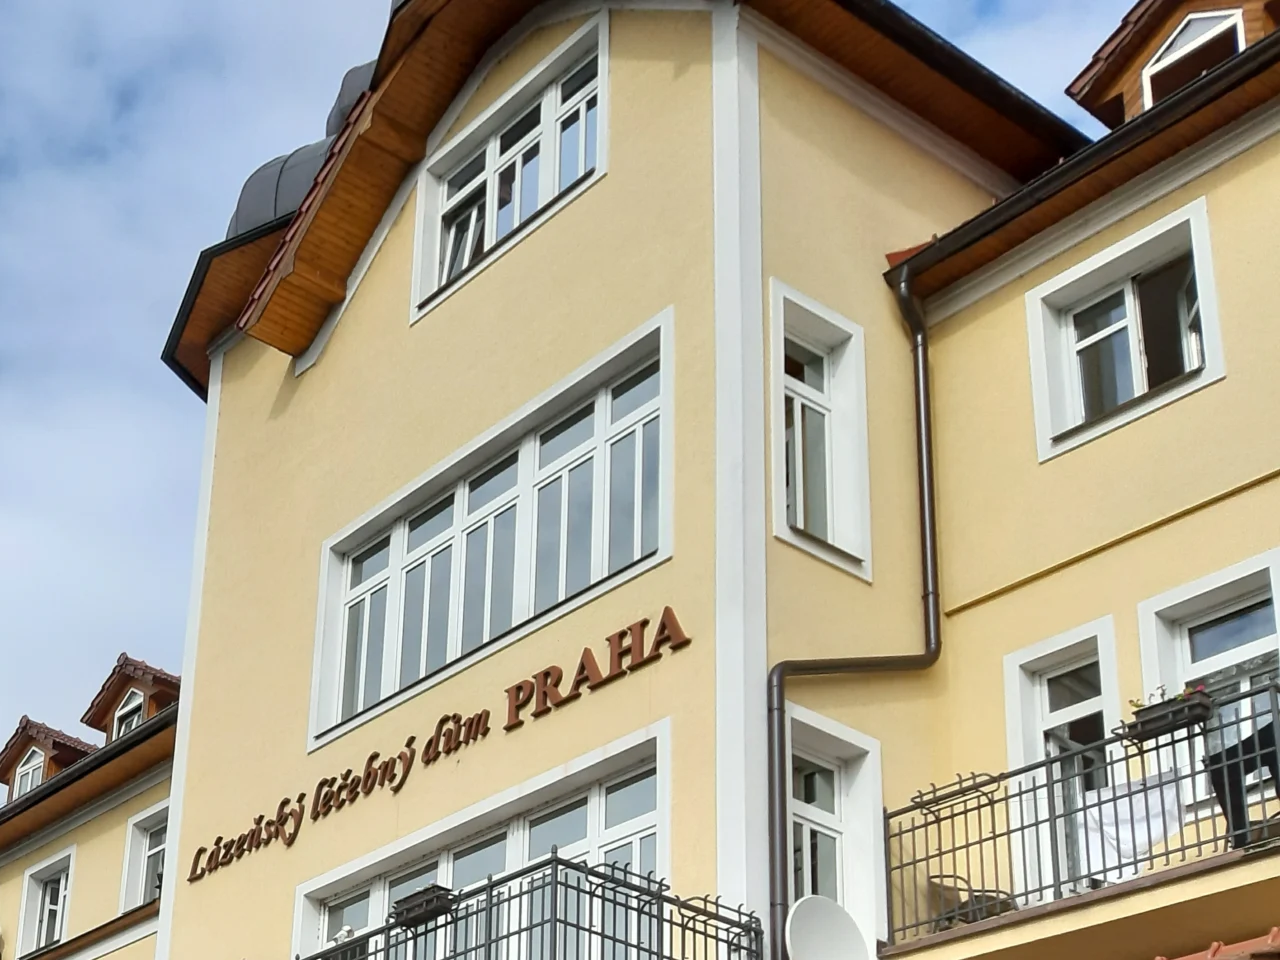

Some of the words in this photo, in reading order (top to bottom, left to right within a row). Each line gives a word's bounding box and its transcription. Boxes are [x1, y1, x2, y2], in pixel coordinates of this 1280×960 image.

[187, 793, 306, 882] Lázeňský
[310, 736, 416, 821] léčebný
[421, 709, 491, 765] dům
[503, 606, 691, 732] PRAHA
